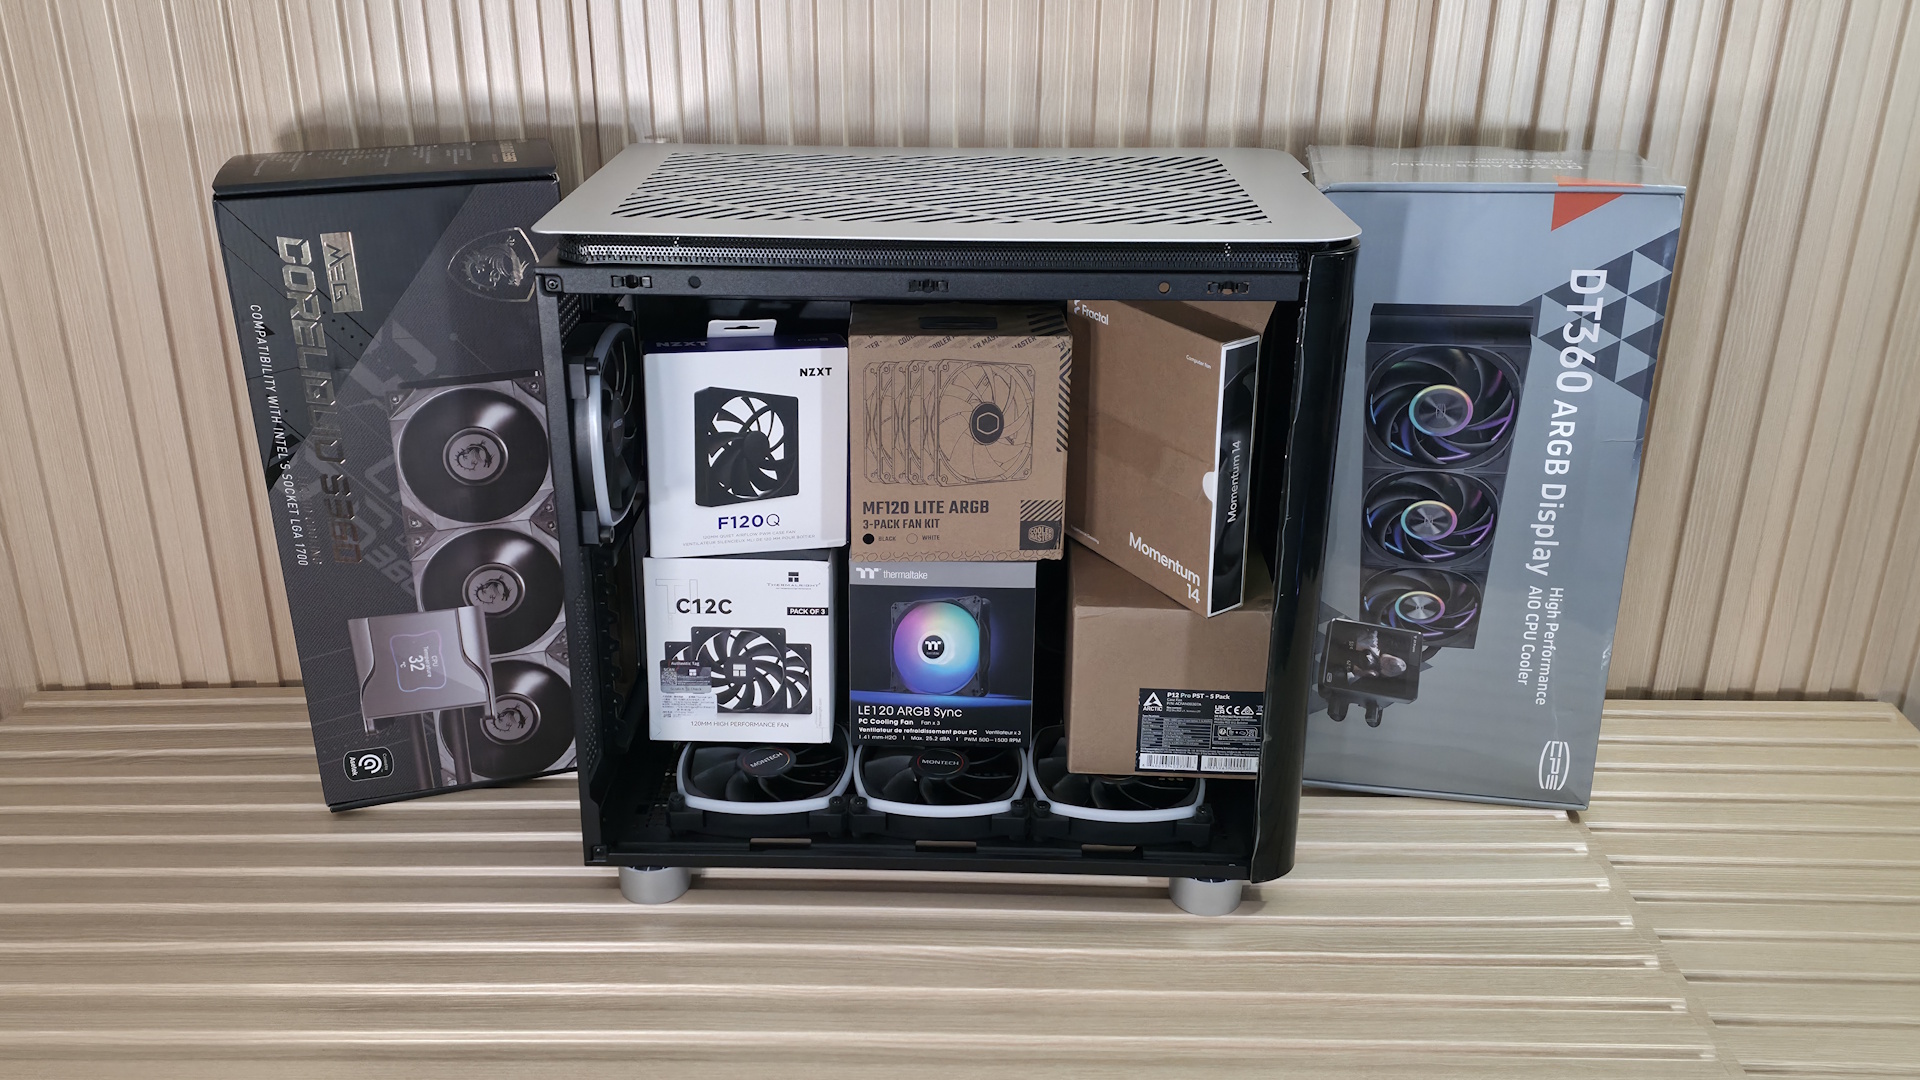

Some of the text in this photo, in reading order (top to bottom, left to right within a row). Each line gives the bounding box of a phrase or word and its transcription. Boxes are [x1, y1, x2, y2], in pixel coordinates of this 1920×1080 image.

[324, 242, 350, 303] MEG
[1082, 304, 1109, 325] Fractal
[250, 304, 277, 392] COMPATIBILITY
[799, 367, 833, 377] NZXT
[267, 395, 282, 424] WITH
[1525, 269, 1608, 576] DT360 ARGB Display
[1227, 440, 1242, 523] Momentum 14
[281, 473, 300, 516] SOCKET
[862, 500, 989, 515] MF120 LITE ARGB
[290, 518, 304, 539] LGA
[862, 518, 941, 529] 3-PACK FAN KIT
[294, 543, 309, 566] 1700
[1129, 531, 1200, 587] Momentum
[883, 570, 928, 579] thermaltake
[1186, 583, 1200, 604] 14
[676, 598, 733, 615] C12C
[1517, 585, 1543, 686] AIO CPU Cooler
[1535, 587, 1564, 706] High Performance
[408, 655, 426, 672] 32
[858, 705, 963, 719] LE120 ARGB Sync
[869, 718, 899, 726] Cooling
[749, 752, 783, 768] MONTECH
